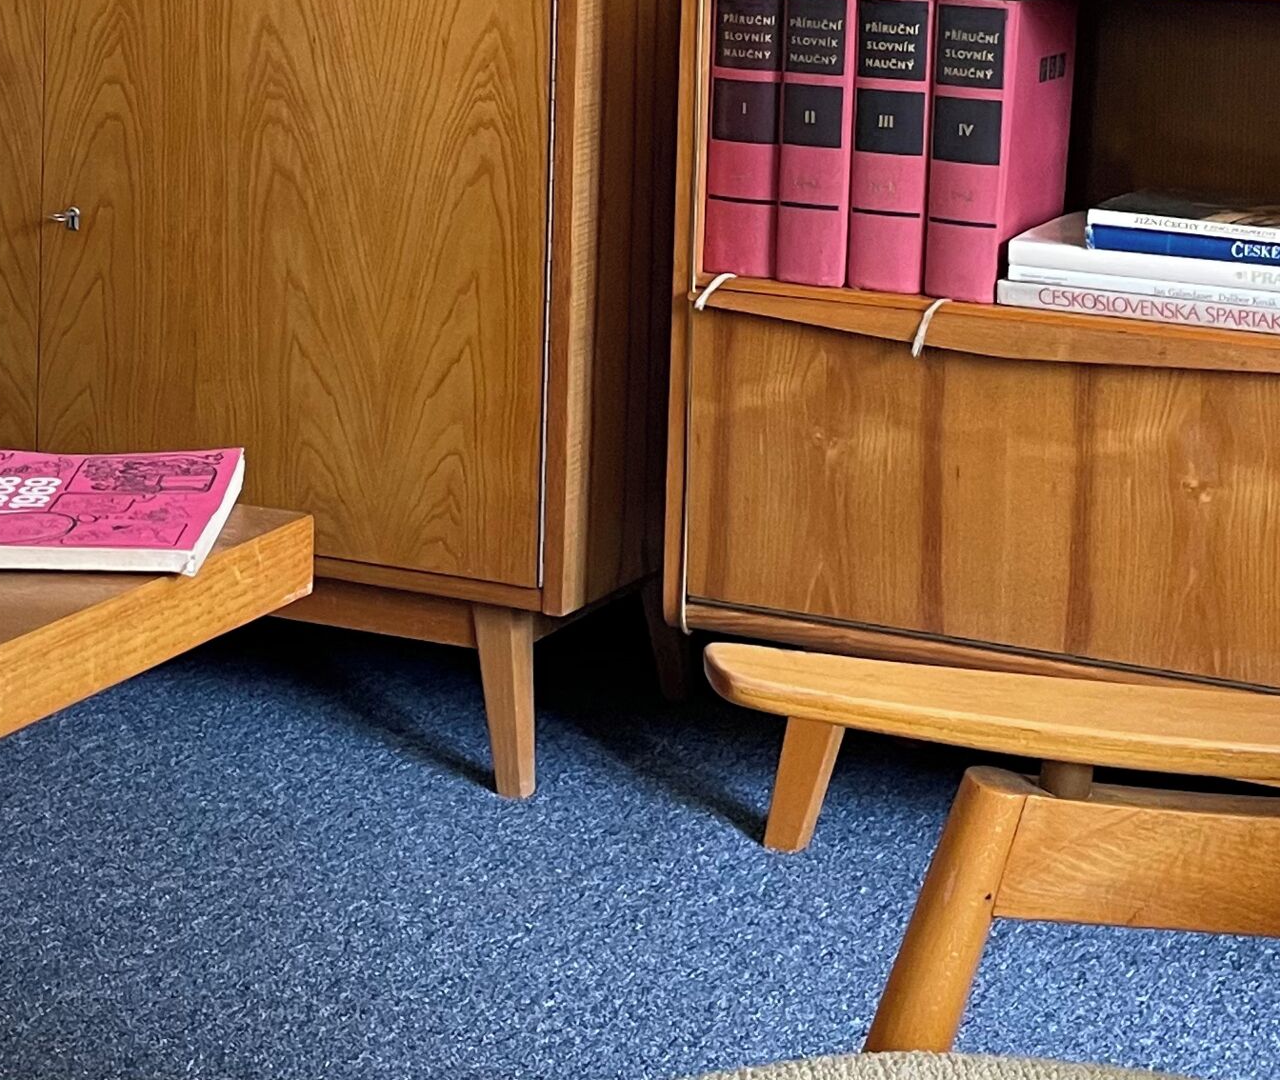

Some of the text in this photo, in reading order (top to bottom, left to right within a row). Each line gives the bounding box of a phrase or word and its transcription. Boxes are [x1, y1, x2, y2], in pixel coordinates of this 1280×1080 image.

[723, 12, 775, 26] PŘÍRUČNÍ
[789, 17, 843, 31] PŘÍRUČNÍ
[865, 21, 920, 35] PŘÍRUČNÍ
[723, 30, 772, 43] SLOVNÍK
[791, 36, 838, 48] SLOVNÍK
[944, 29, 999, 45] PŘÍRUČNÍ
[866, 40, 916, 53] SLOVNÍK
[723, 48, 771, 60] NAUČNÝ
[789, 52, 837, 65] NAUČNÝ
[944, 48, 995, 62] SLOVNÍK
[865, 57, 915, 70] NAUČNÝ
[944, 66, 993, 81] NAUČNÝ
[804, 110, 816, 124] II
[878, 115, 894, 128] III
[958, 123, 974, 137] IV
[1231, 240, 1280, 260] ČESKÉ
[8, 477, 63, 509] 1969
